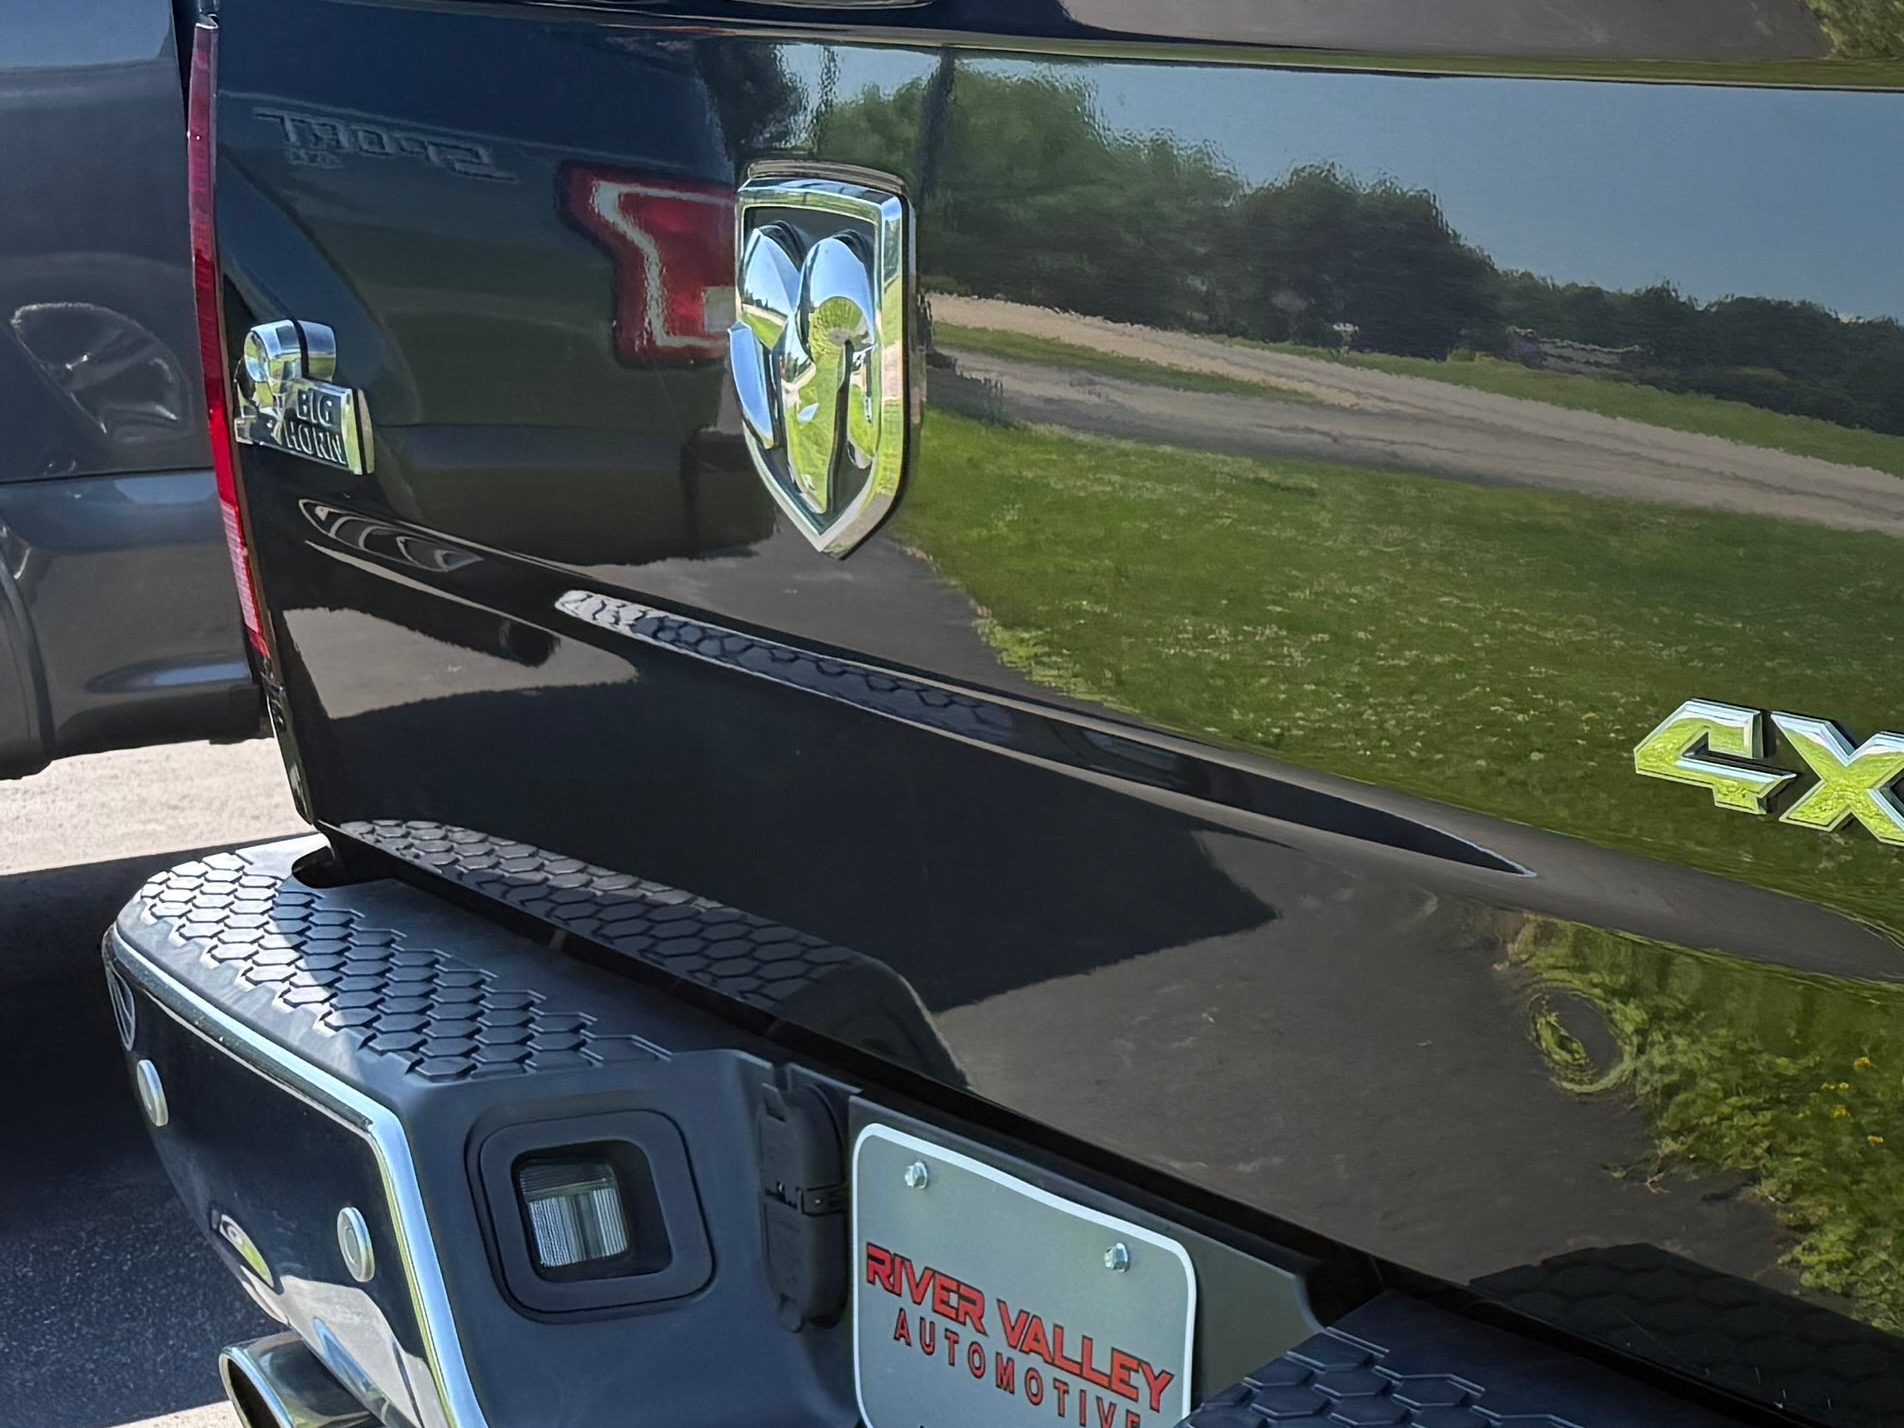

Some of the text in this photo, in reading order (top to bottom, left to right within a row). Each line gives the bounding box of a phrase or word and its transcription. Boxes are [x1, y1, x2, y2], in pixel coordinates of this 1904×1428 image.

[296, 388, 334, 427] BIG
[284, 420, 347, 465] HORN
[865, 1241, 1174, 1413] RIVER VALLEY
